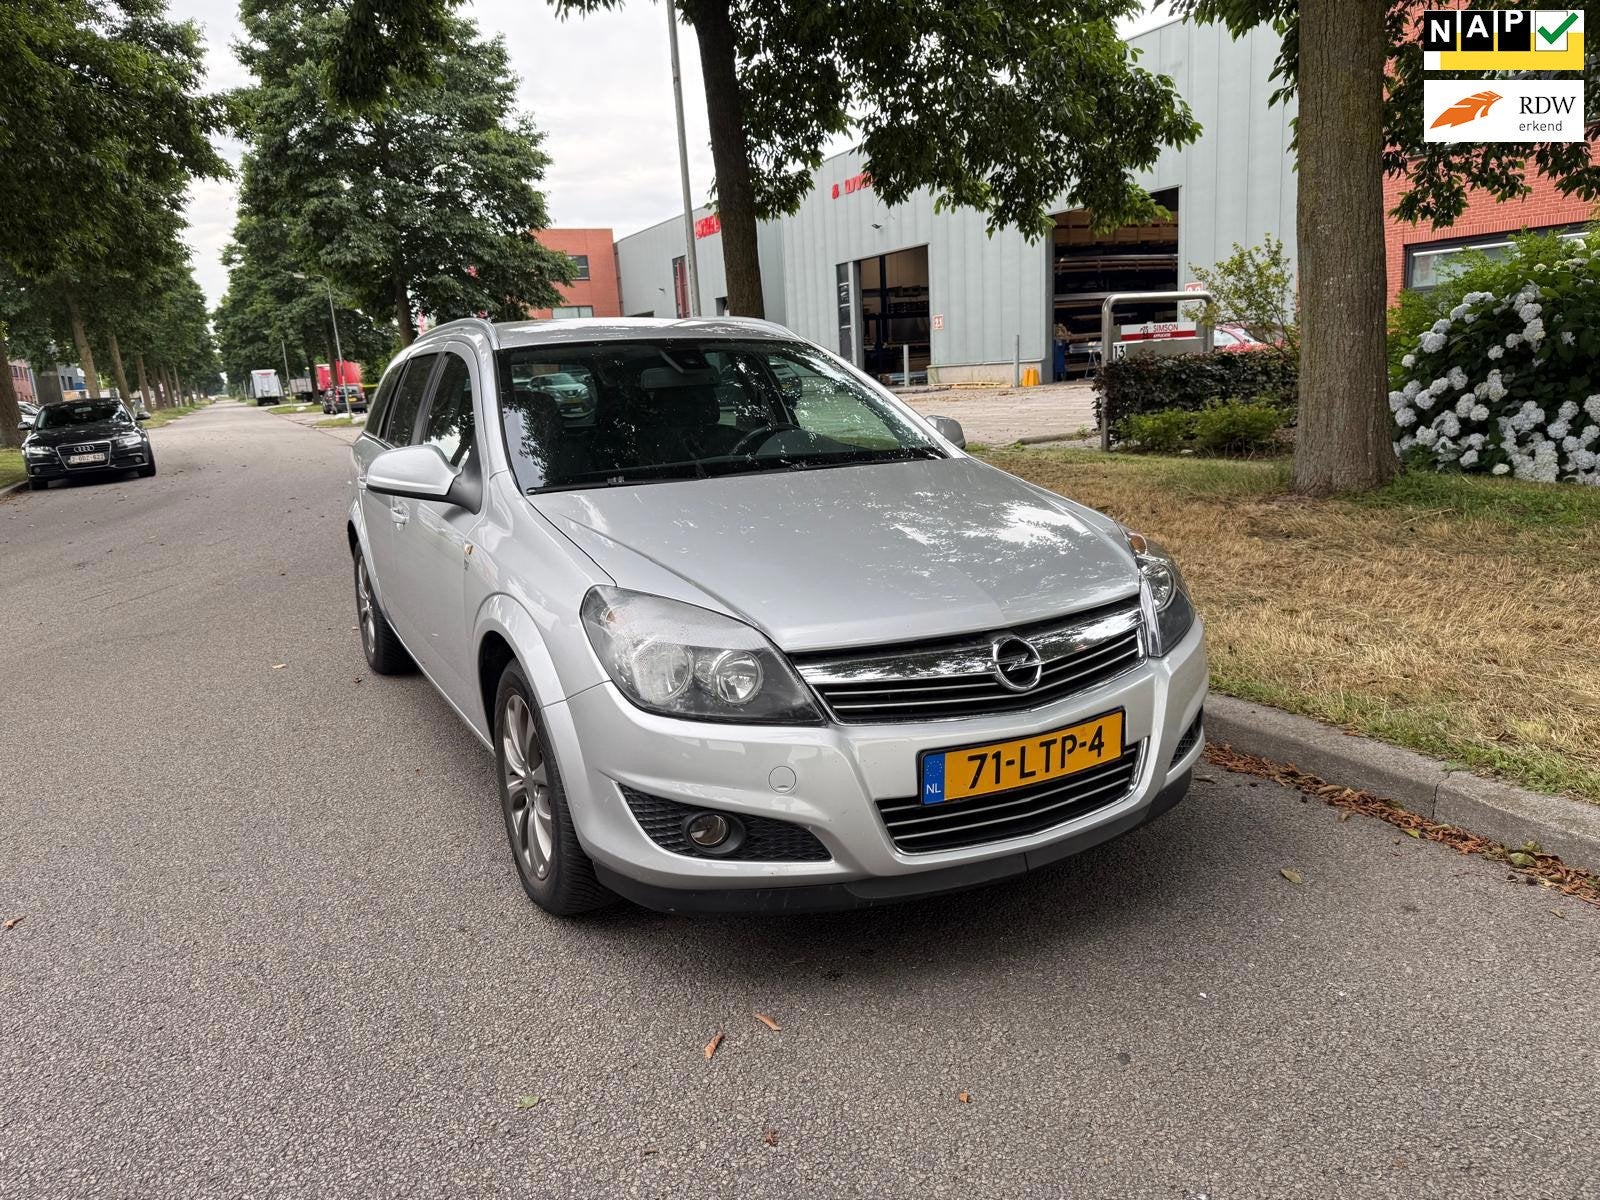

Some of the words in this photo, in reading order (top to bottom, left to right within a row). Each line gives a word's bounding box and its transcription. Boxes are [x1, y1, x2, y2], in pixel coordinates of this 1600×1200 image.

[1153, 323, 1179, 333] SIMSON
[1113, 345, 1126, 360] 13
[967, 725, 1105, 790] 71-LTP-4
[926, 783, 942, 794] NL
